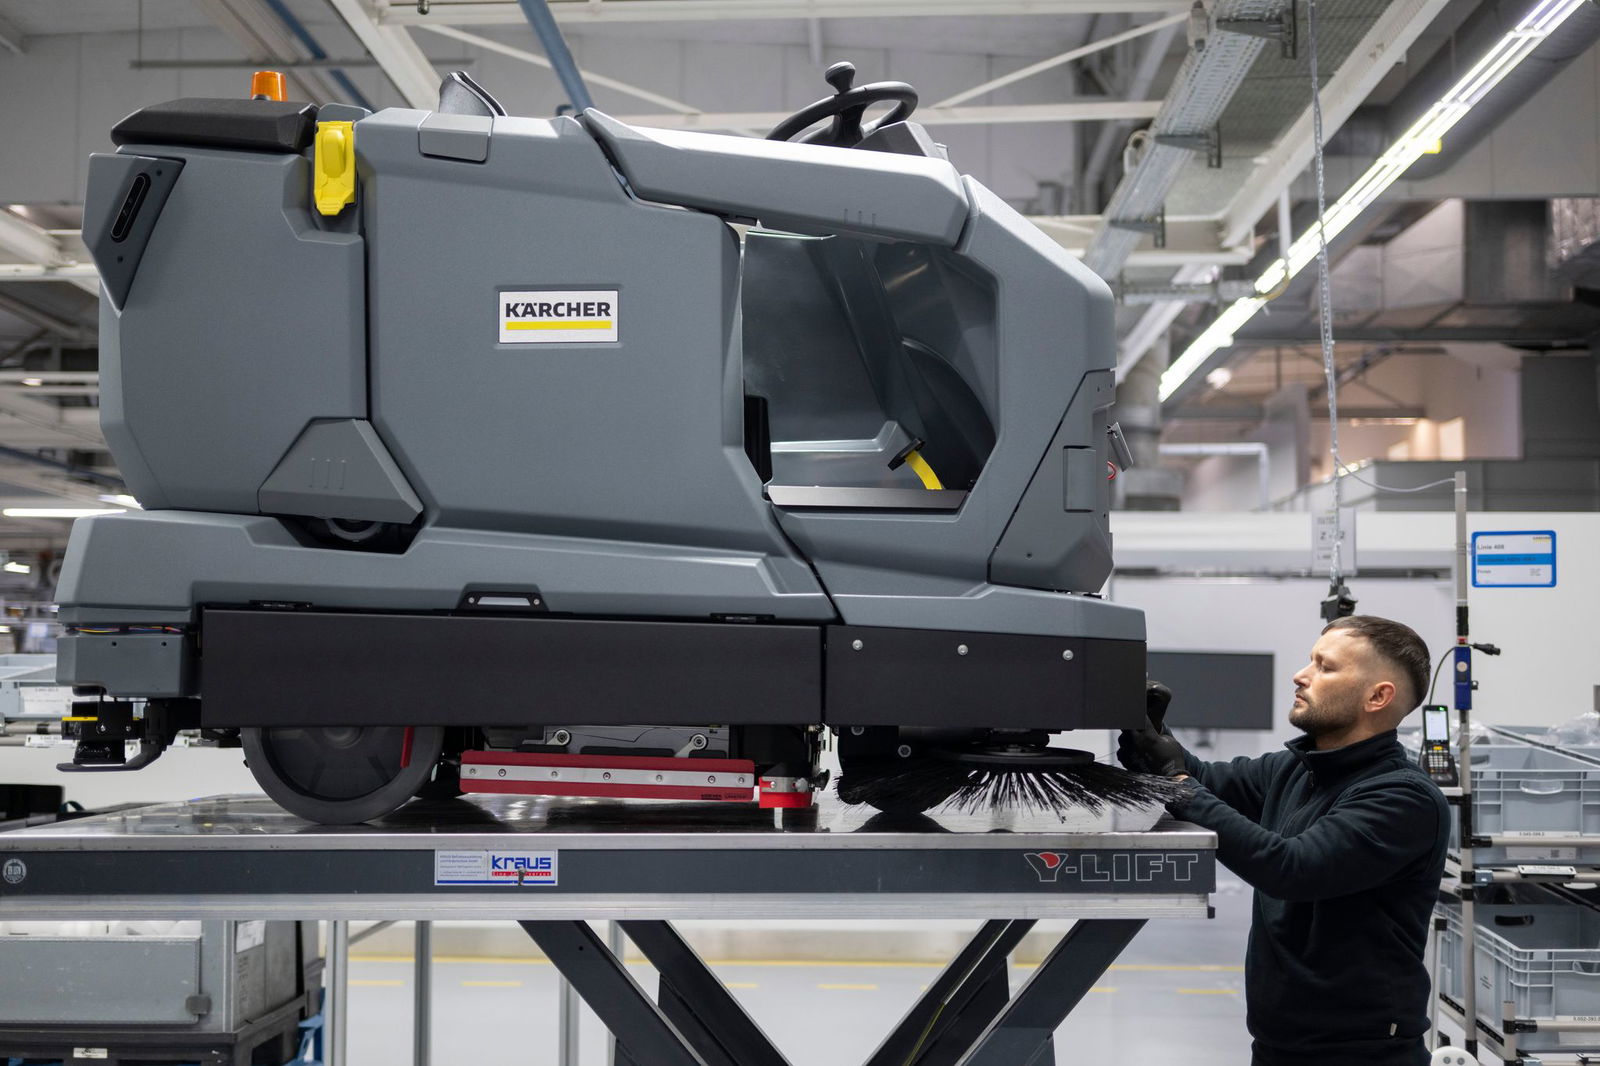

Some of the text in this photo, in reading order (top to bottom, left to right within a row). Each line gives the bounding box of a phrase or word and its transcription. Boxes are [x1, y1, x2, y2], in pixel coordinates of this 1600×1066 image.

[505, 302, 611, 318] KÄRCHER
[491, 855, 552, 870] kraus
[1023, 852, 1198, 882] Y-LIFT
